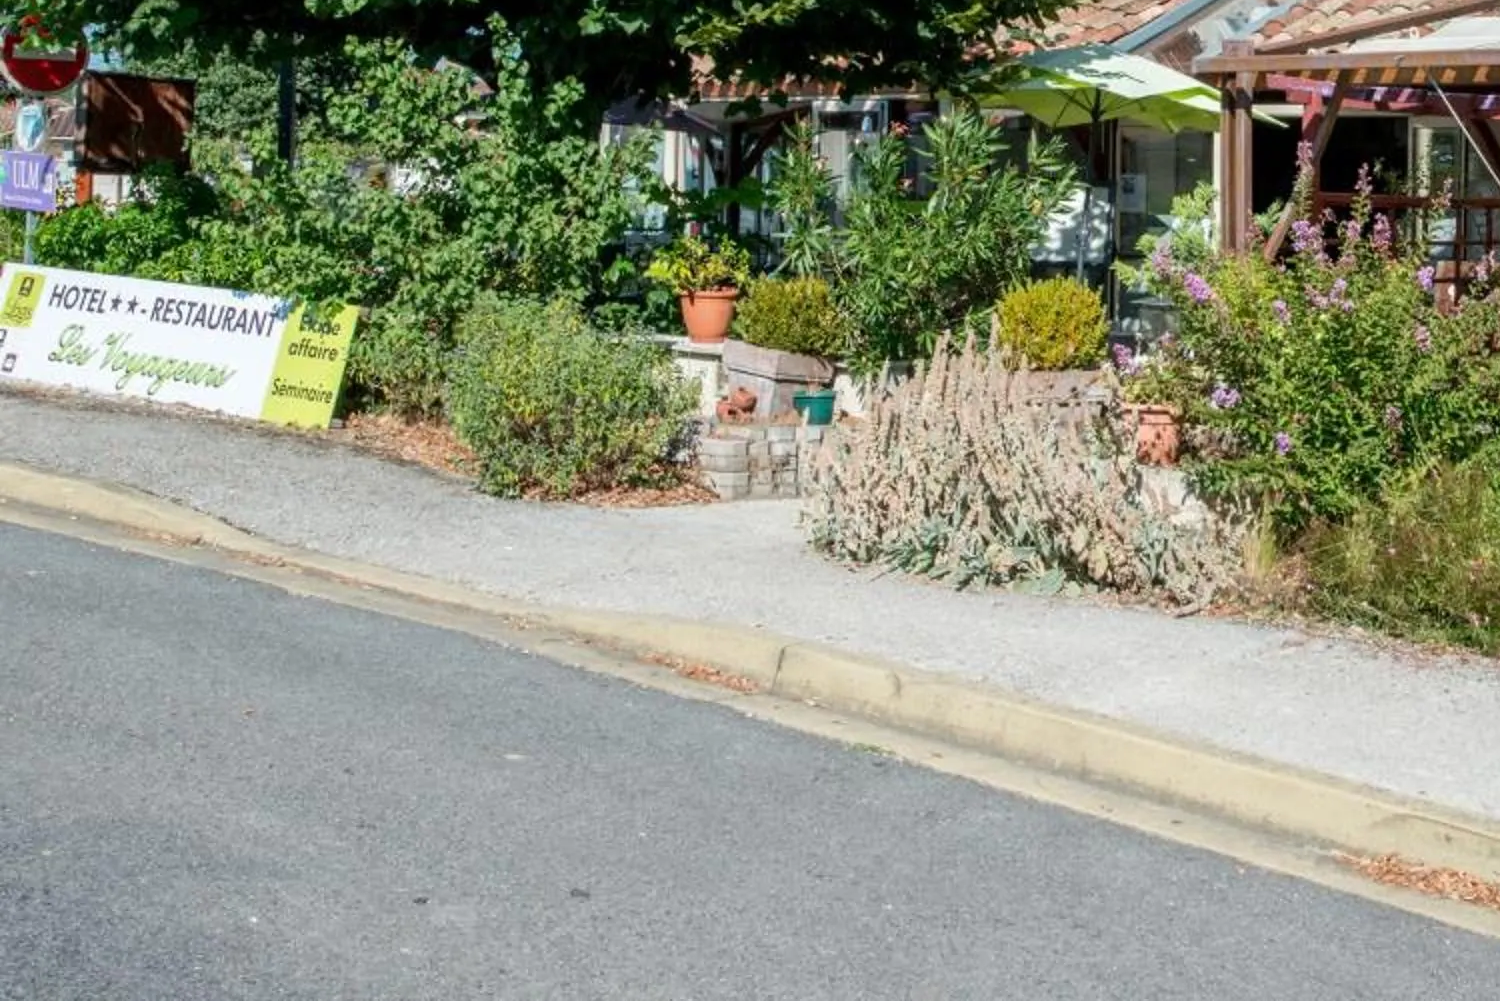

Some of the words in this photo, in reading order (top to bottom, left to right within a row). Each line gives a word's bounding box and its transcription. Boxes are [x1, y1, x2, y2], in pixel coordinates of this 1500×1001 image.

[48, 284, 107, 314] HOTEL
[150, 297, 277, 337] RESTAURANT
[48, 324, 99, 366] Les
[99, 332, 237, 396] Voyageurs
[288, 338, 339, 362] affaire
[271, 377, 333, 404] Séminaire
